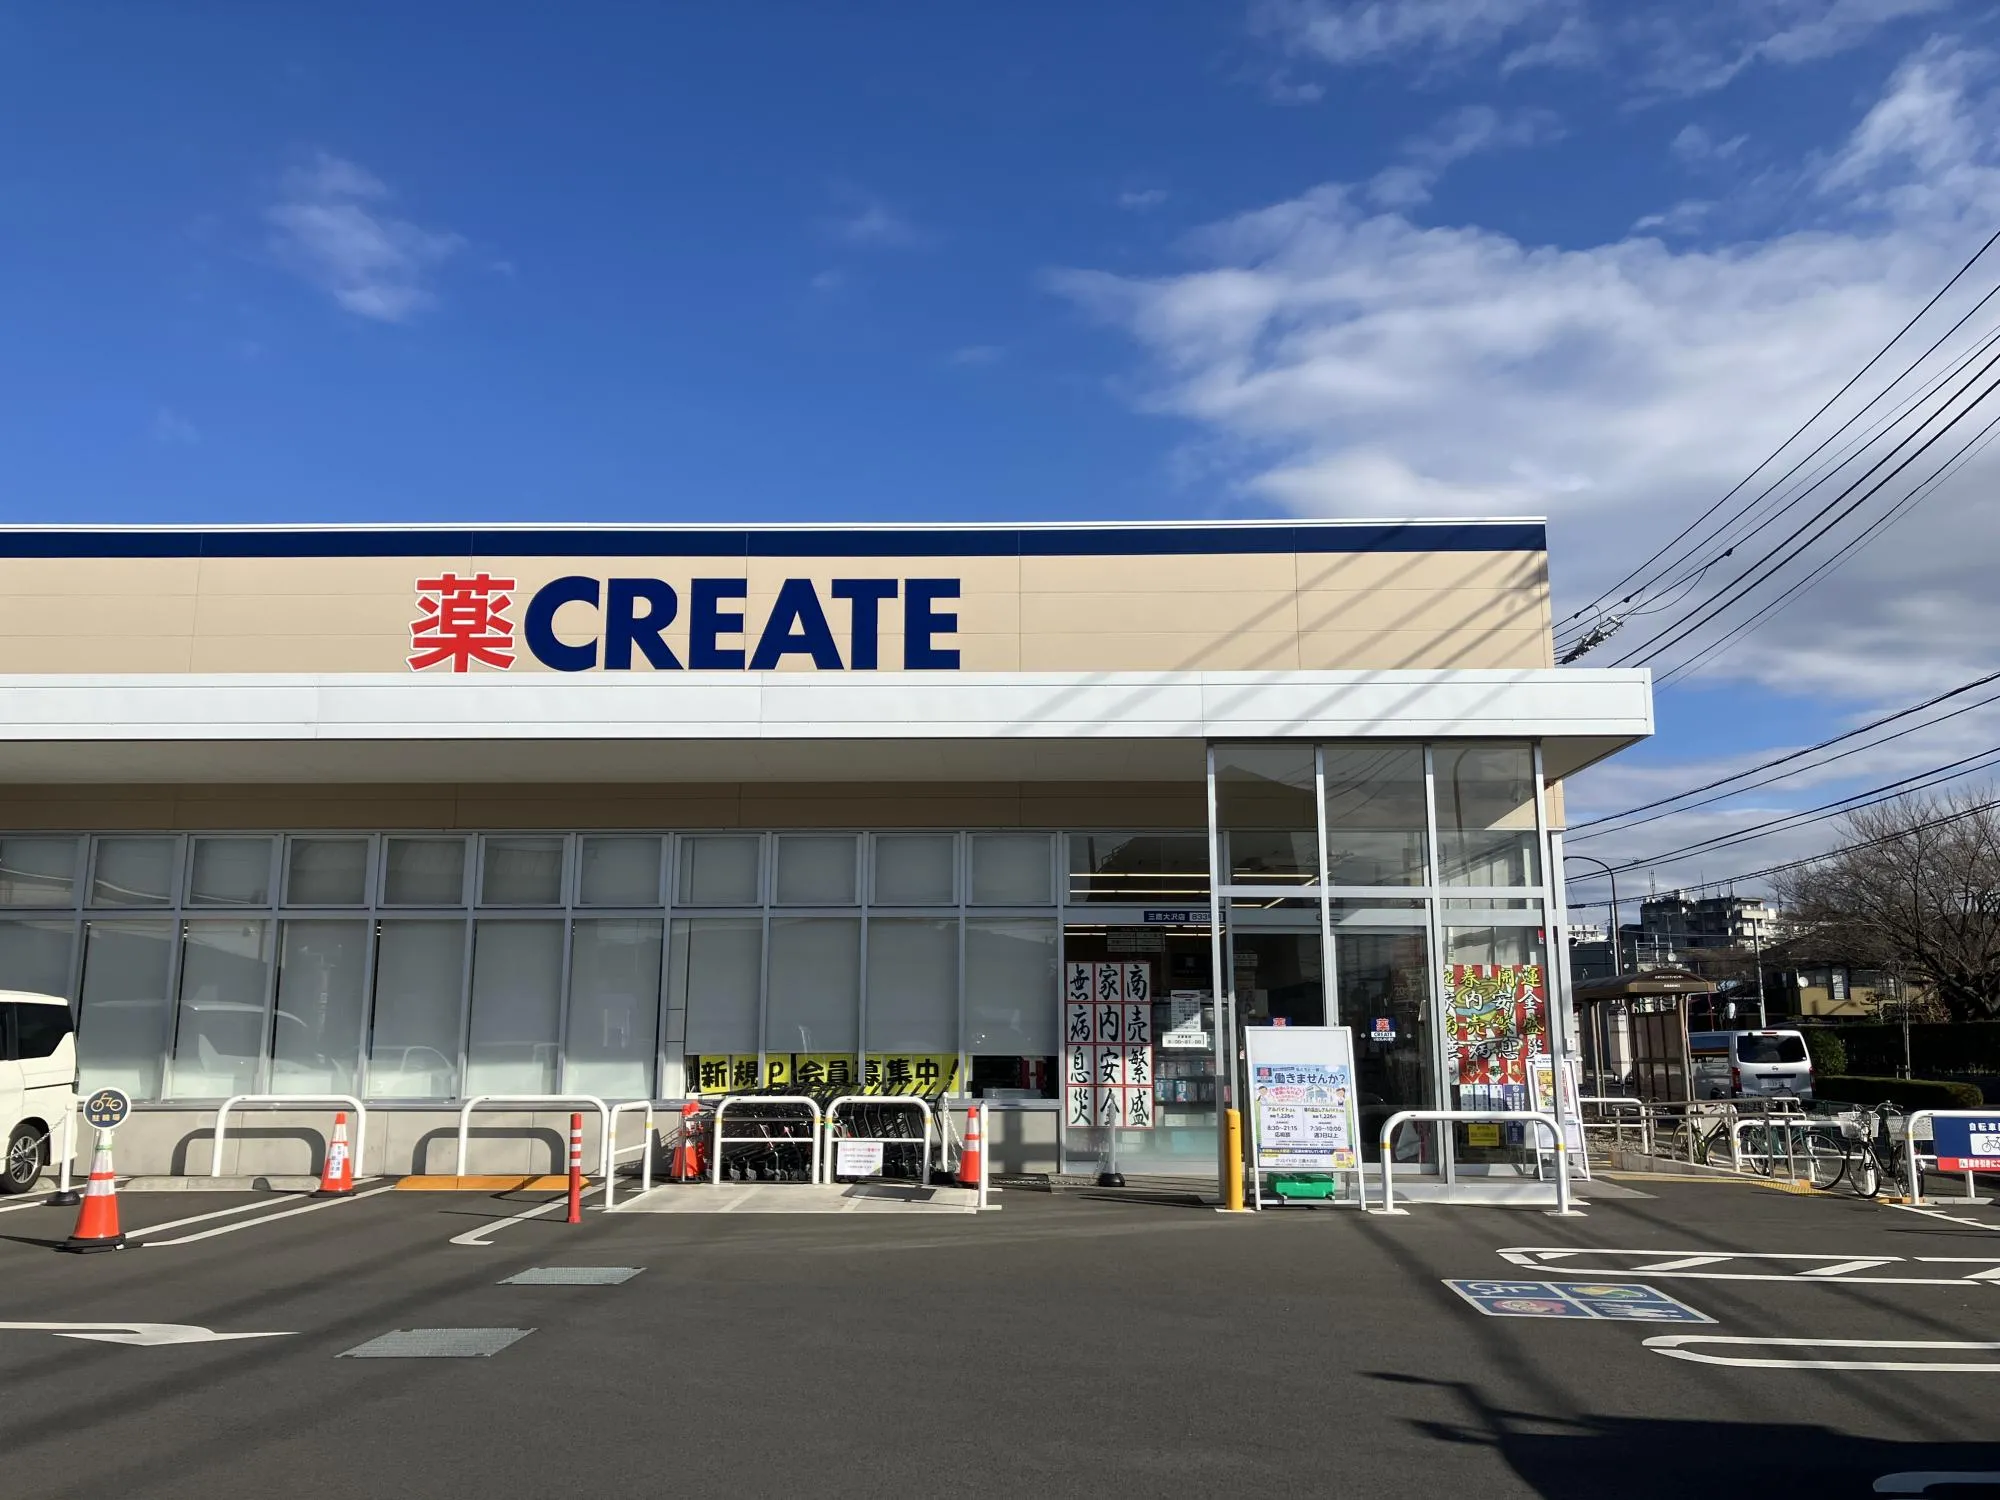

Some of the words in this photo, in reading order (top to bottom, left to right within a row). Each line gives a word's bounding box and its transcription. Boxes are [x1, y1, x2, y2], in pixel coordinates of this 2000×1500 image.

[409, 572, 517, 672] 薬
[524, 576, 961, 671] CREATE
[1070, 963, 1091, 1126] 無病息災
[1098, 963, 1120, 1126] 家内安全
[1126, 964, 1150, 1127] 商売繁盛
[1274, 1073, 1346, 1084] 働きませんか?
[1968, 1122, 2000, 1132] 自転車
